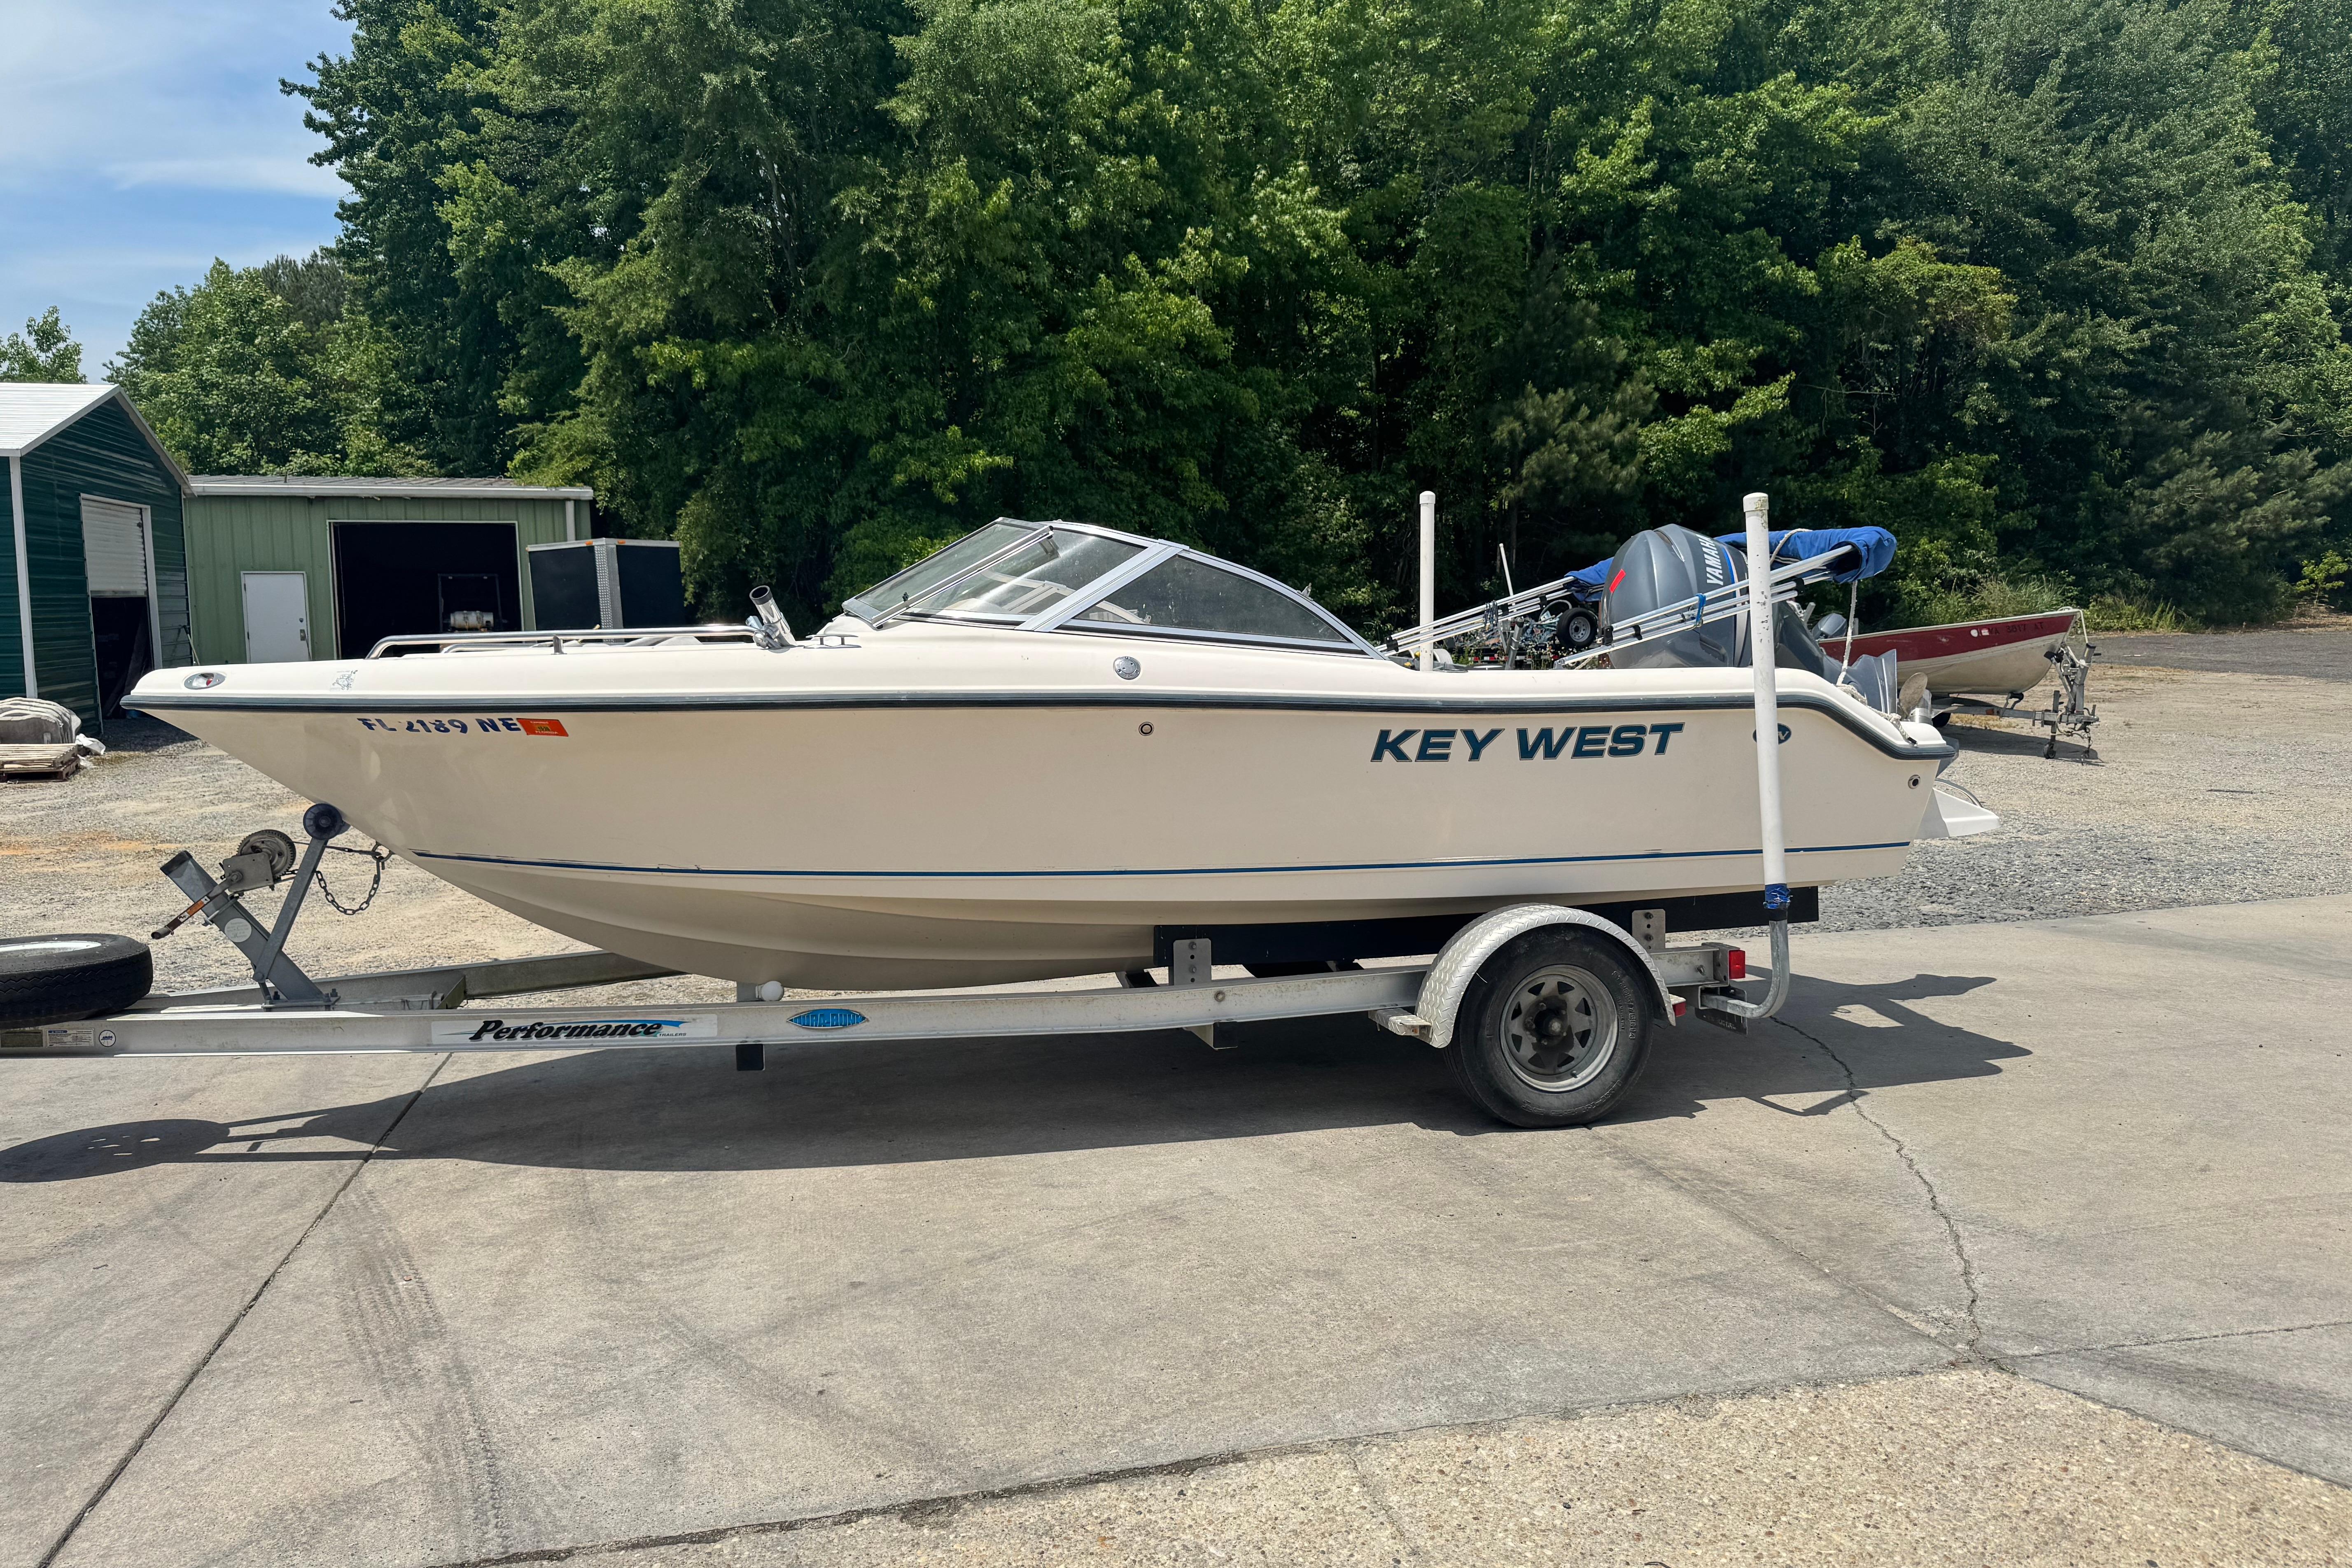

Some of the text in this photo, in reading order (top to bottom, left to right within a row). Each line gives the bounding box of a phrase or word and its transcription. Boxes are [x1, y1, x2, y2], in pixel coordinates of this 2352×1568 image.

[357, 718, 397, 731] FL
[475, 718, 521, 732] NE
[1370, 722, 1685, 762] KEY WEST
[469, 1020, 662, 1041] Performance
